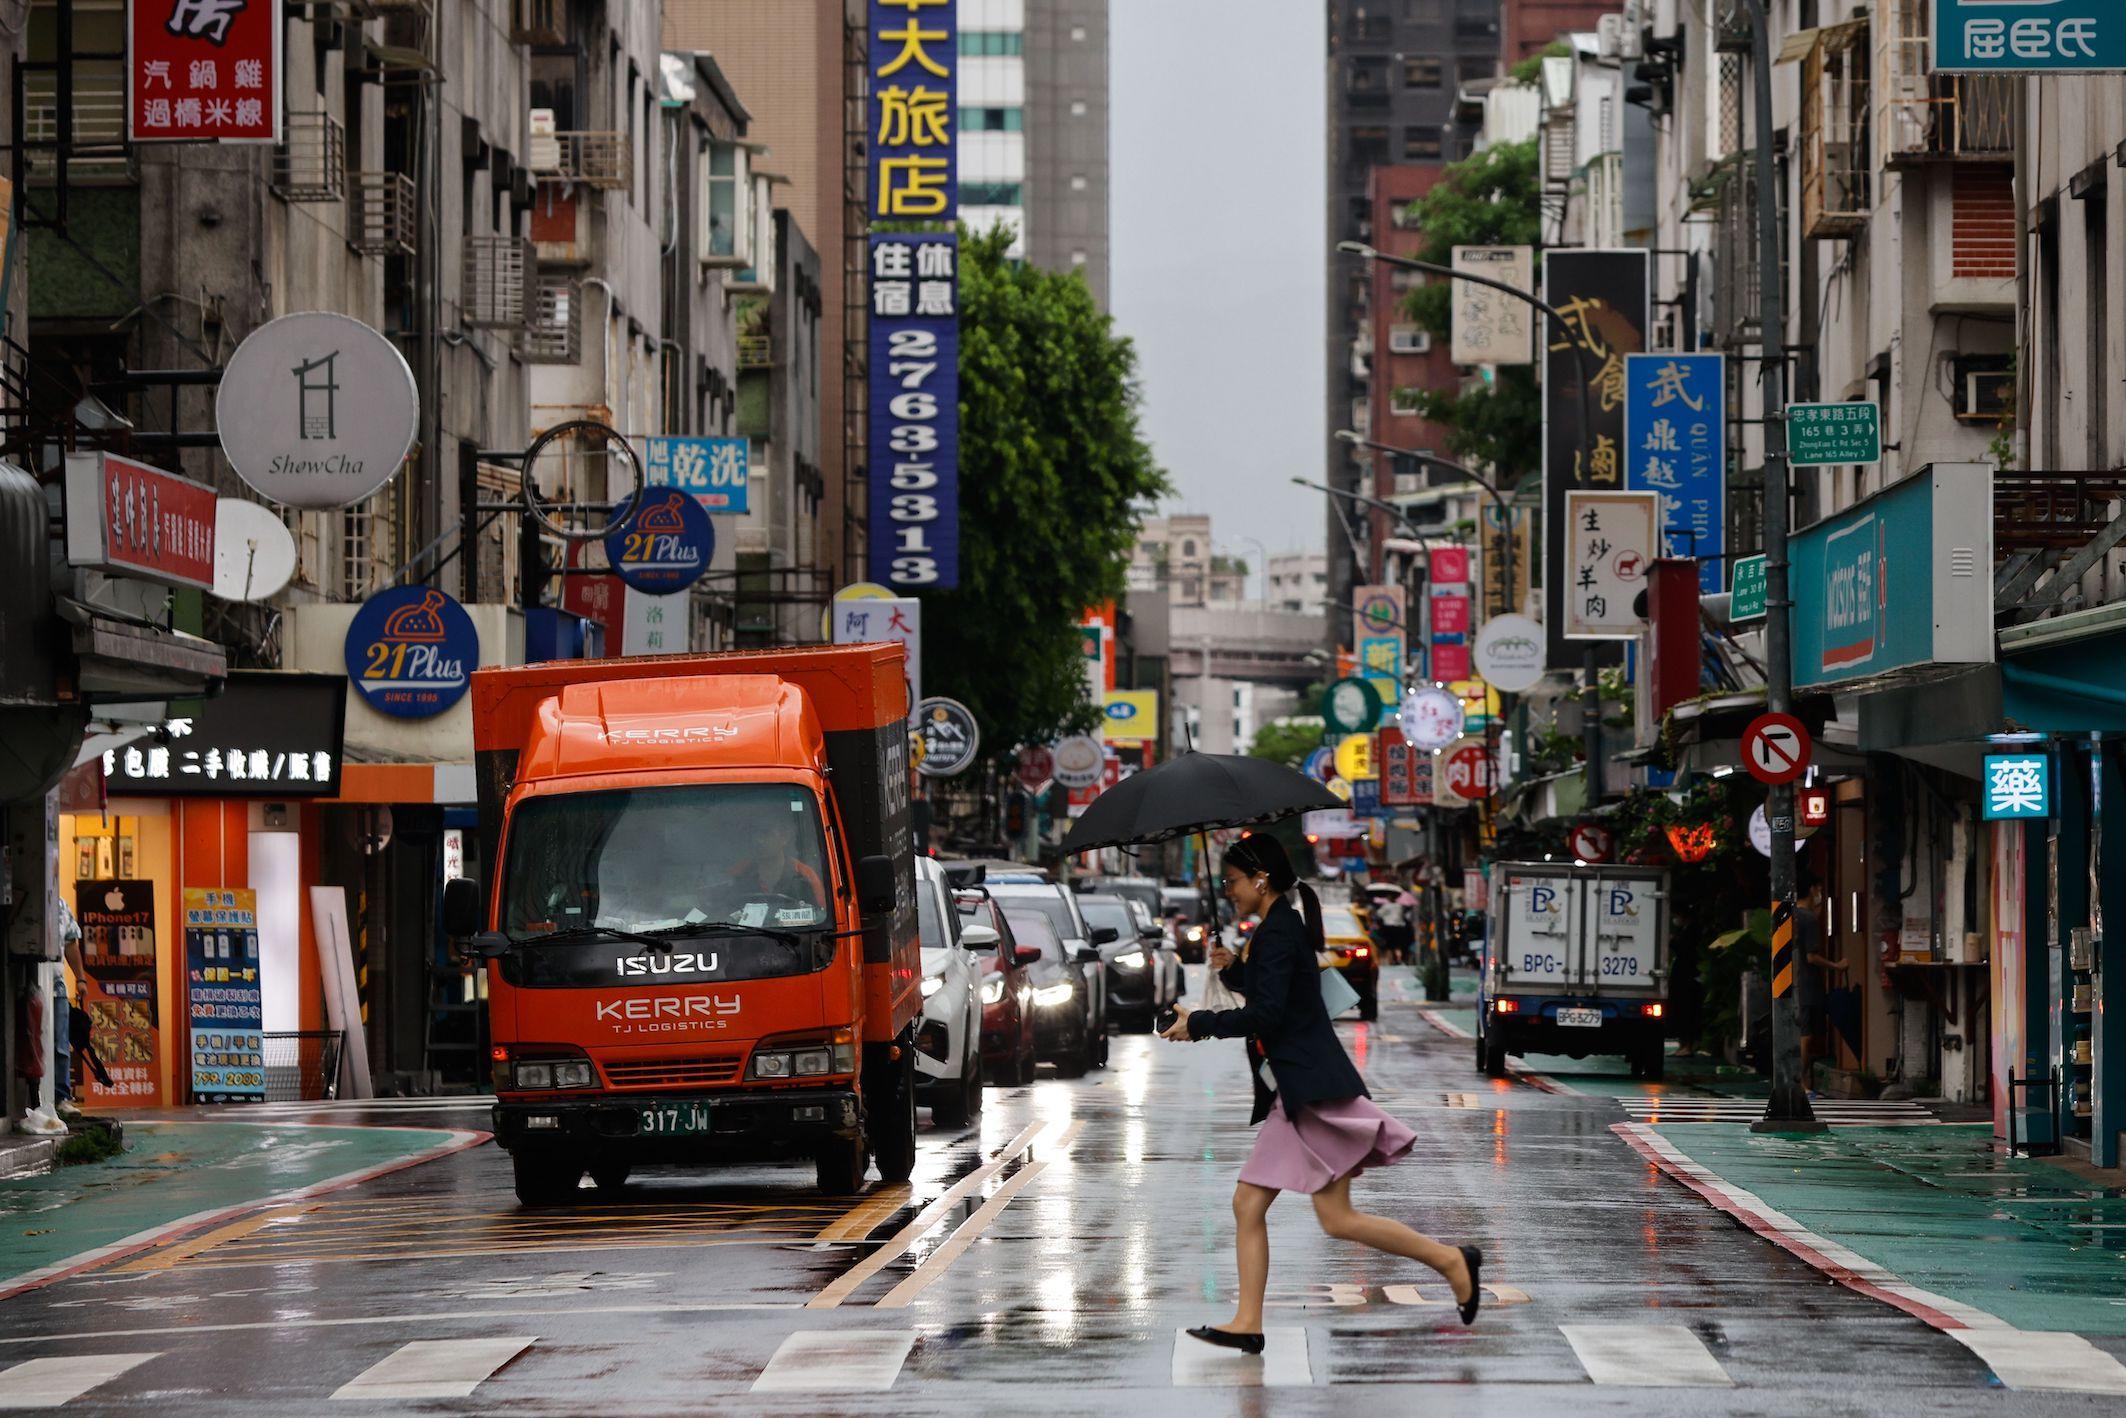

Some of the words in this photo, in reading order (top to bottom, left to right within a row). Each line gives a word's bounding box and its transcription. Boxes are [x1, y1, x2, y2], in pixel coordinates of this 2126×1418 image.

[143, 60, 263, 91] 汽鍋雞
[143, 98, 263, 128] 過橋米線
[876, 0, 949, 216] 大旅店
[1794, 406, 1870, 423] 忠孝東路五段
[1801, 426, 1821, 437] 165
[1840, 425, 1849, 436] 3
[268, 454, 364, 476] ShowCha
[673, 443, 745, 488] 乾洗
[1577, 508, 1612, 618] 生炒羊肉
[597, 726, 738, 740] KERRY
[636, 736, 724, 745] LOGISTICS
[1990, 759, 2042, 812] 藥
[616, 952, 718, 977] ISUZU
[1523, 954, 1562, 973] BPG-
[1602, 957, 1638, 976] 3279
[596, 993, 741, 1021] KERRY
[612, 1025, 632, 1033] TJ
[638, 1020, 727, 1032] LOGISTICS
